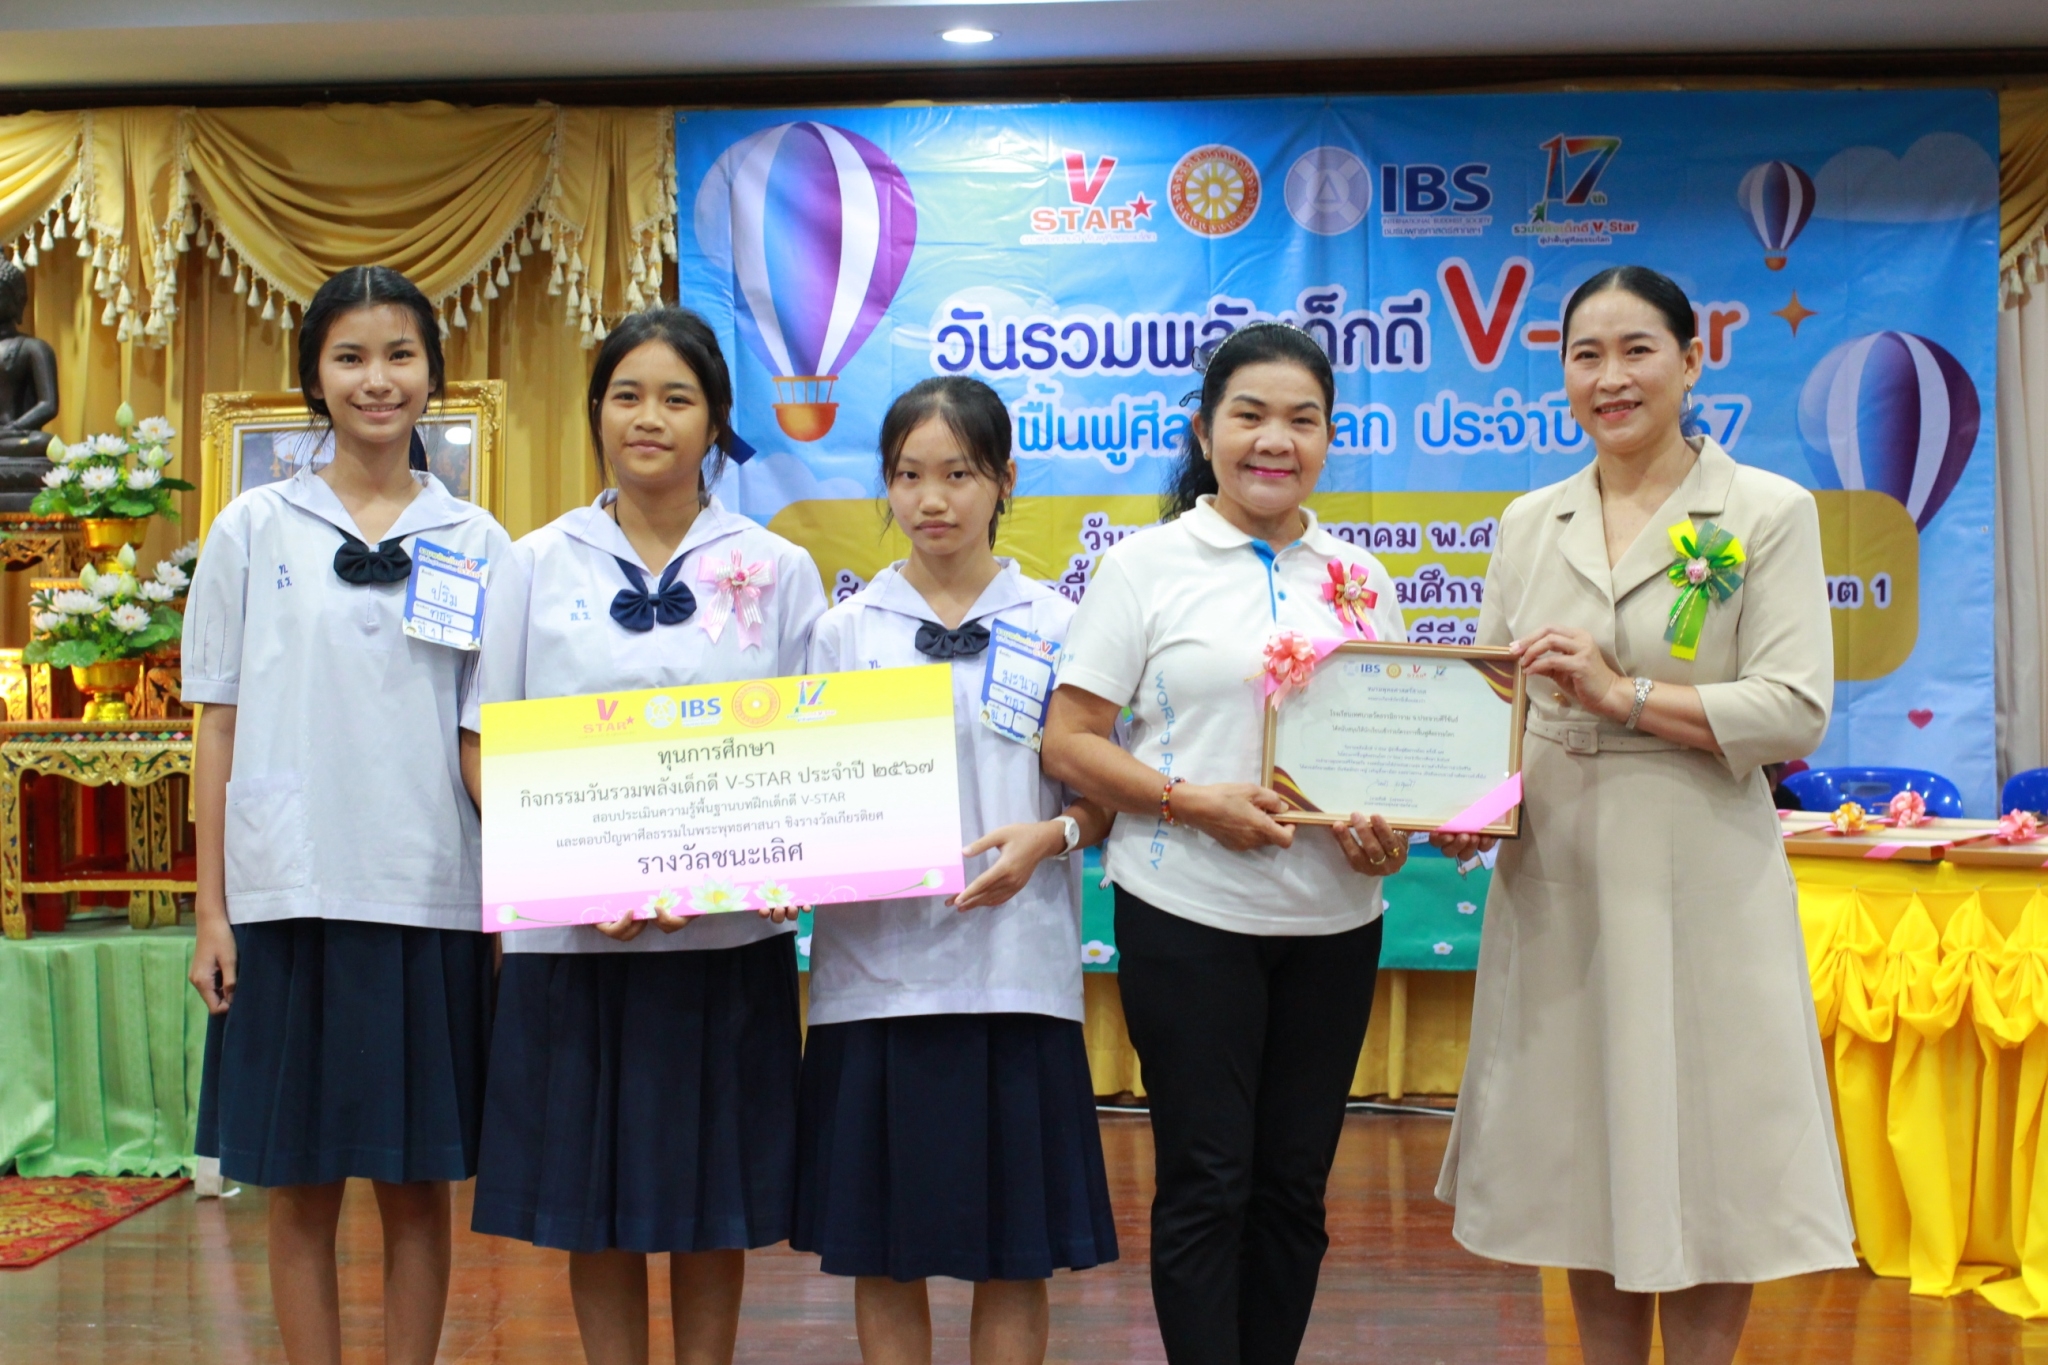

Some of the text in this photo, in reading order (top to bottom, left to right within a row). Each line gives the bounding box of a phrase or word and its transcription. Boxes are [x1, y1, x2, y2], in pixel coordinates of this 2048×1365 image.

[1064, 150, 1116, 206] V
[1382, 164, 1491, 213] IBS
[1032, 209, 1134, 231] STAR
[937, 291, 1423, 371] วันรวมพลัด็กดี
[1876, 579, 1886, 602] 1
[1361, 663, 1381, 674] IBS
[1412, 664, 1421, 674] V
[596, 698, 618, 721] V
[681, 698, 721, 718] IBS
[1155, 670, 1177, 746] WORLD
[583, 722, 627, 734] STAR
[658, 737, 775, 771] ทุนการศึกษา
[520, 758, 934, 808] กิจกรรมวันรวมพลังเด็กดี V-STAR ประจำปี ๒๕๖๗
[801, 791, 846, 805] V-STAR
[637, 836, 803, 875] รางวัลชนะเลิศ
